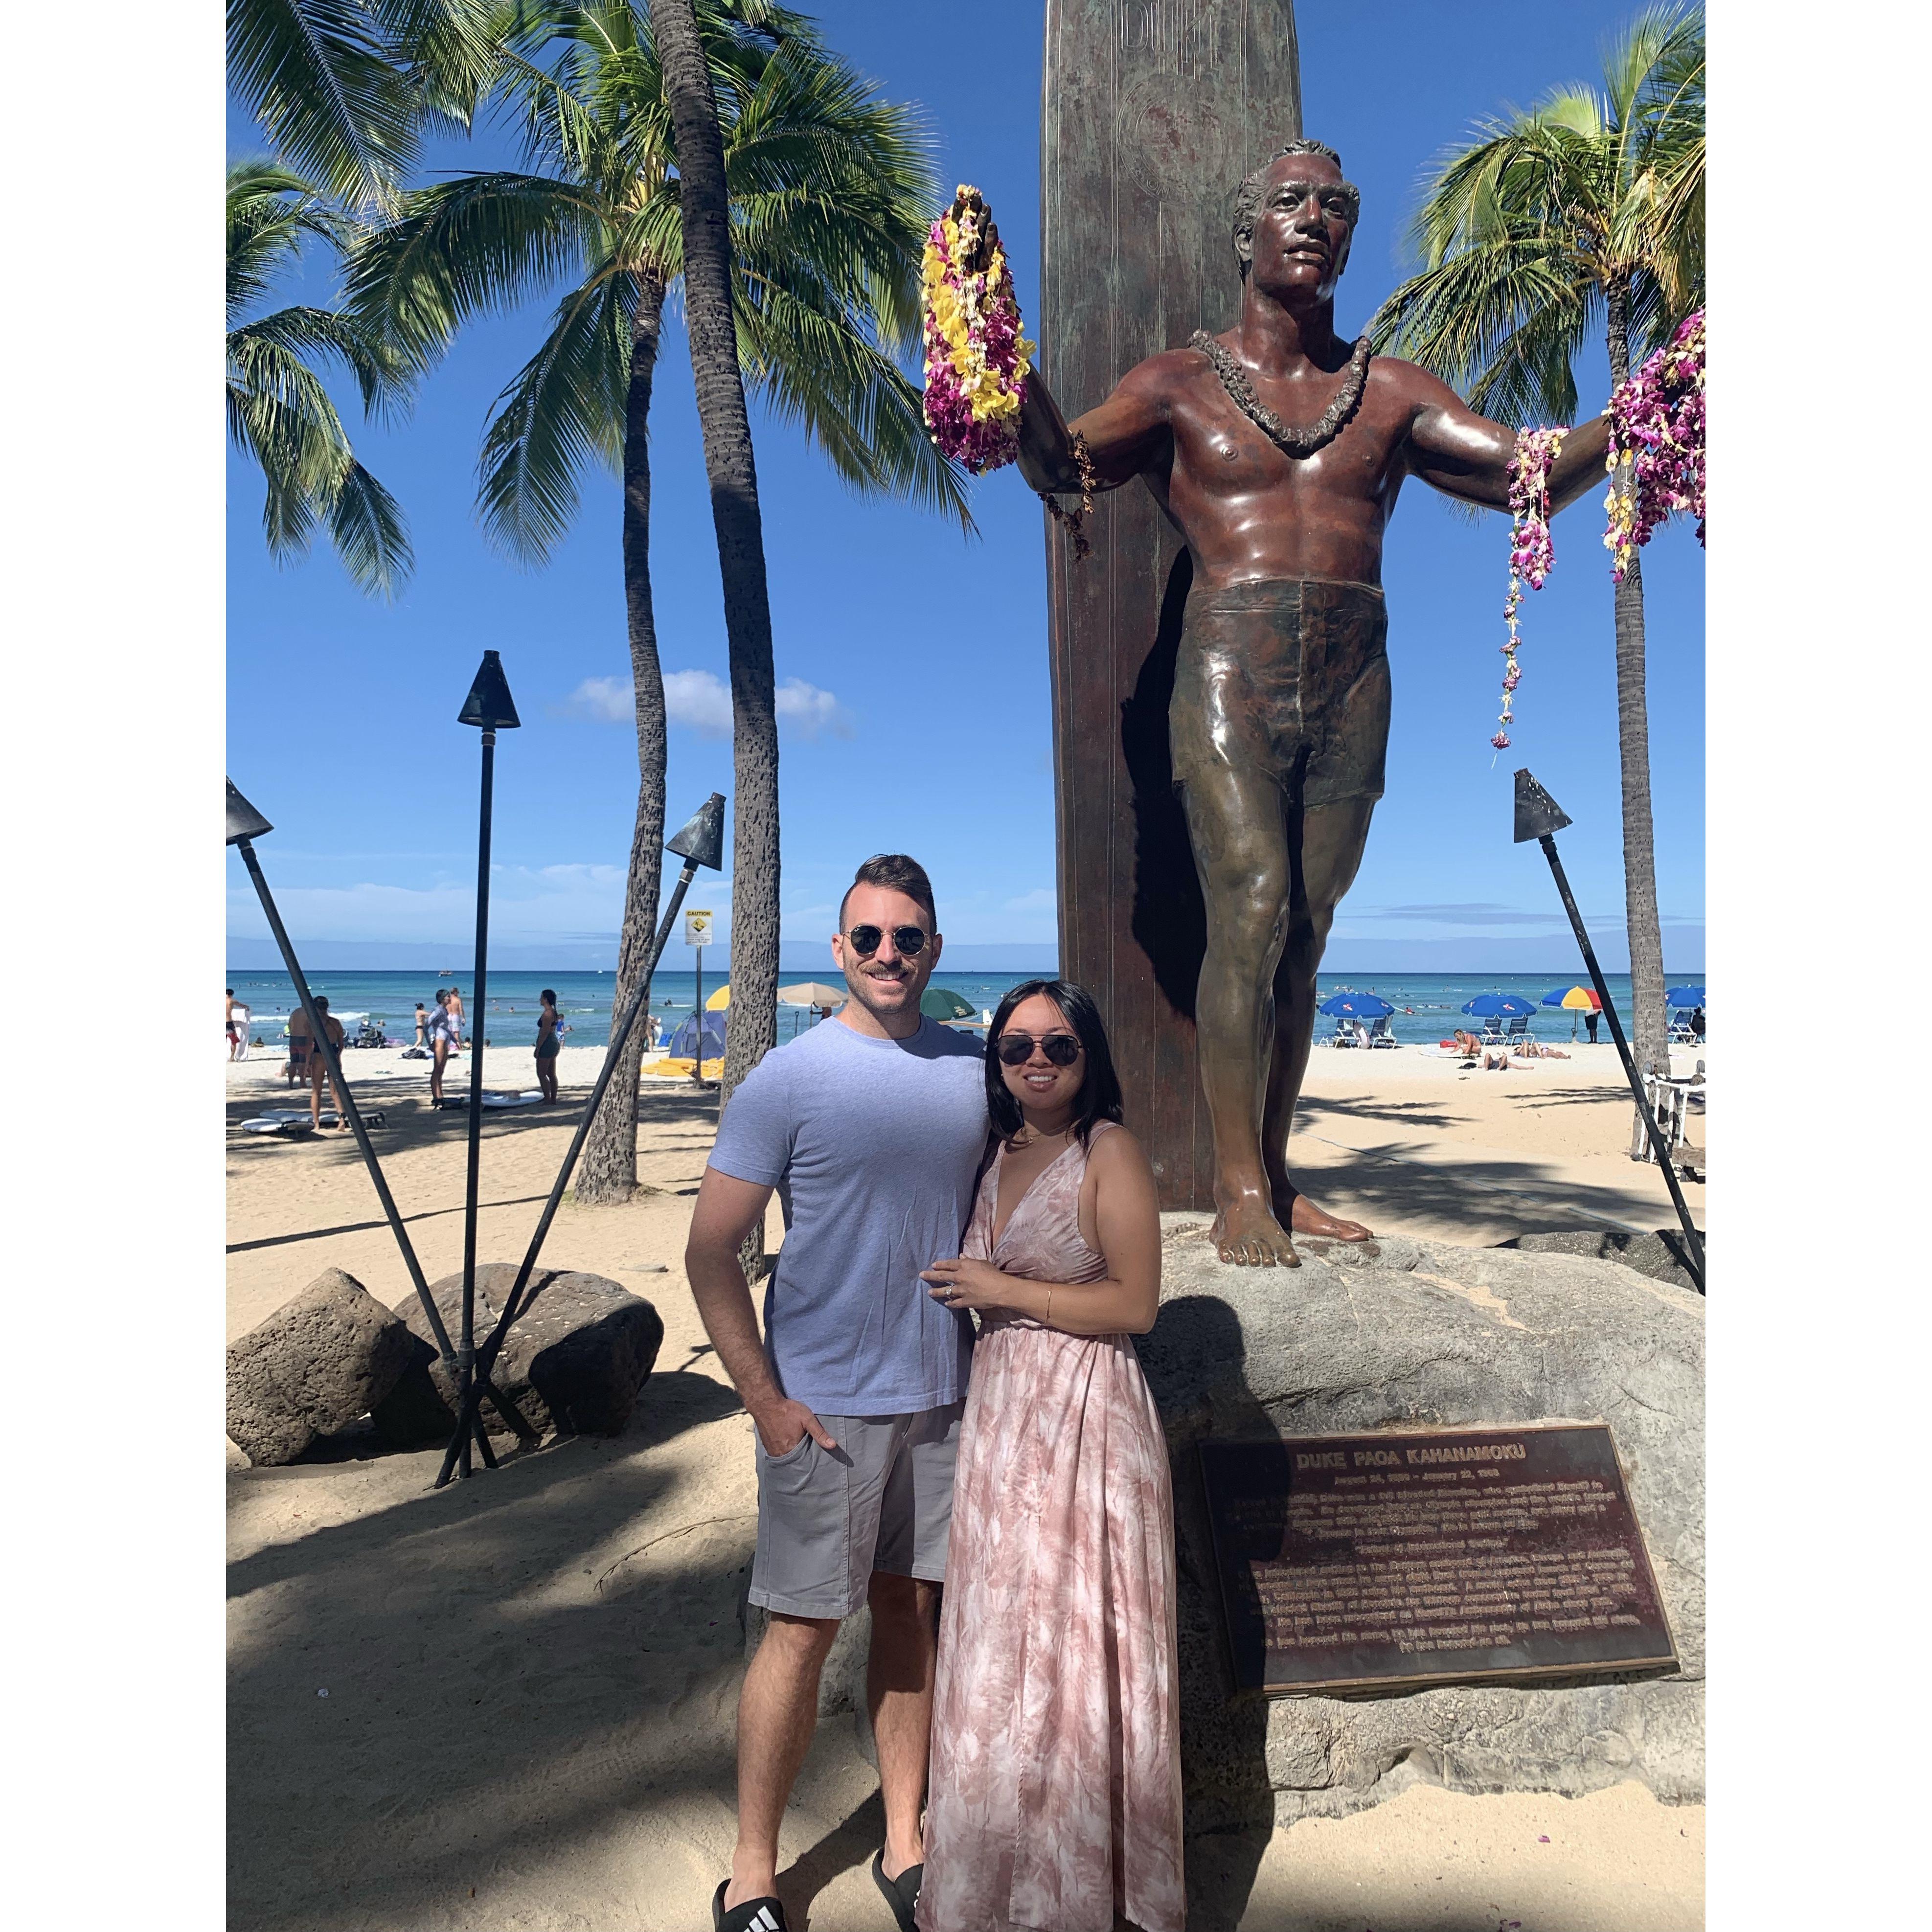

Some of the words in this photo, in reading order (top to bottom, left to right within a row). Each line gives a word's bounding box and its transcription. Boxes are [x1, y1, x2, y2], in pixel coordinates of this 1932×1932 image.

[1297, 1452, 1346, 1468] DUKE
[1353, 1451, 1401, 1467] PAOA
[1407, 1444, 1526, 1464] KAHANAMOKU
